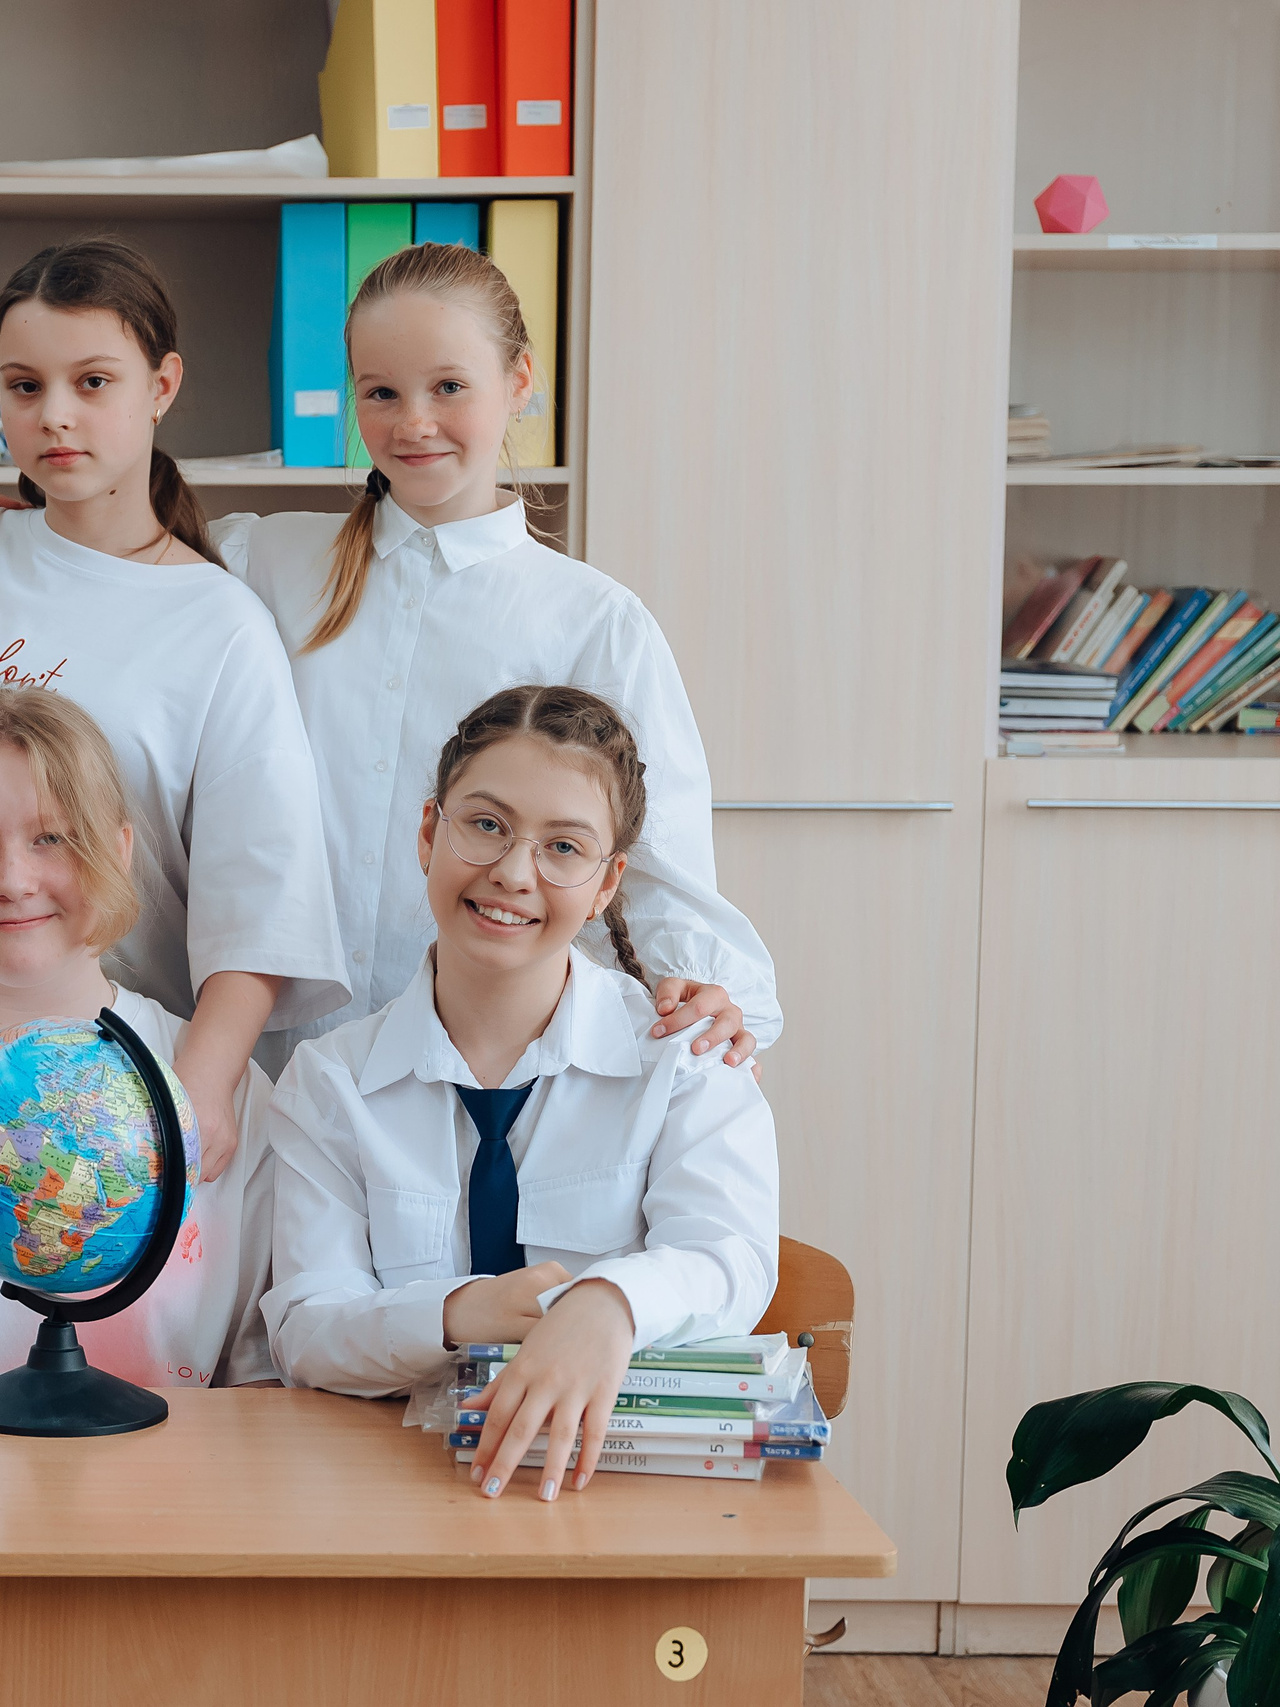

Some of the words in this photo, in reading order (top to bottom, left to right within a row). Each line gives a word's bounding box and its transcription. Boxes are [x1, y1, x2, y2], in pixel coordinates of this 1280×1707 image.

[167, 1361, 211, 1384] LOV
[620, 1375, 682, 1389] ОЛОГИЯ
[607, 1419, 644, 1429] ТИКА
[719, 1422, 733, 1432] 5
[710, 1444, 724, 1453] 5
[667, 1639, 685, 1669] 3
